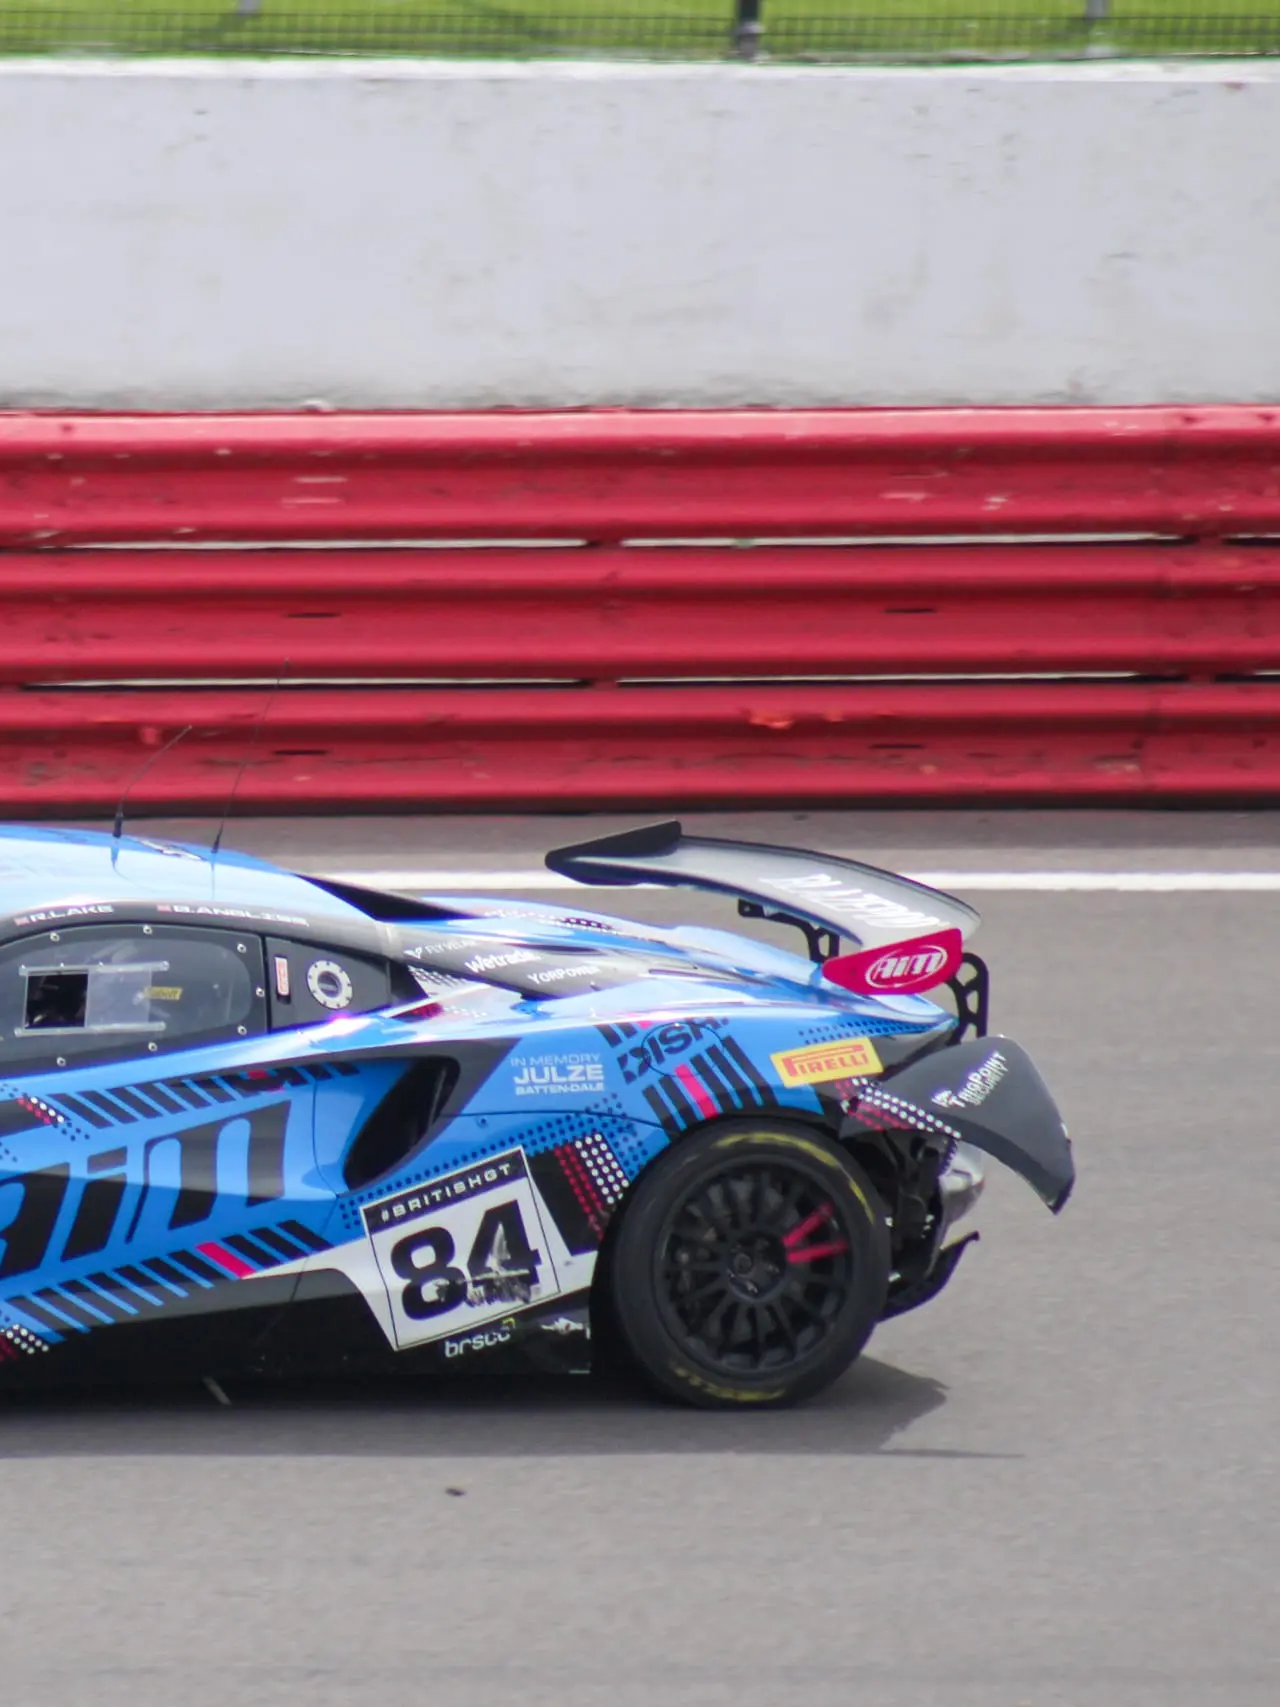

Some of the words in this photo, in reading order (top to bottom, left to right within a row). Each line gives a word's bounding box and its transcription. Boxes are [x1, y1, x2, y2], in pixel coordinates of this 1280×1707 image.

[510, 1056, 526, 1066] IN
[530, 1053, 600, 1066] MEMORY
[513, 1064, 604, 1084] JULZE
[782, 1044, 868, 1077] PIRELLI
[381, 1163, 512, 1222] #BRITISHGT
[390, 1199, 542, 1321] 84
